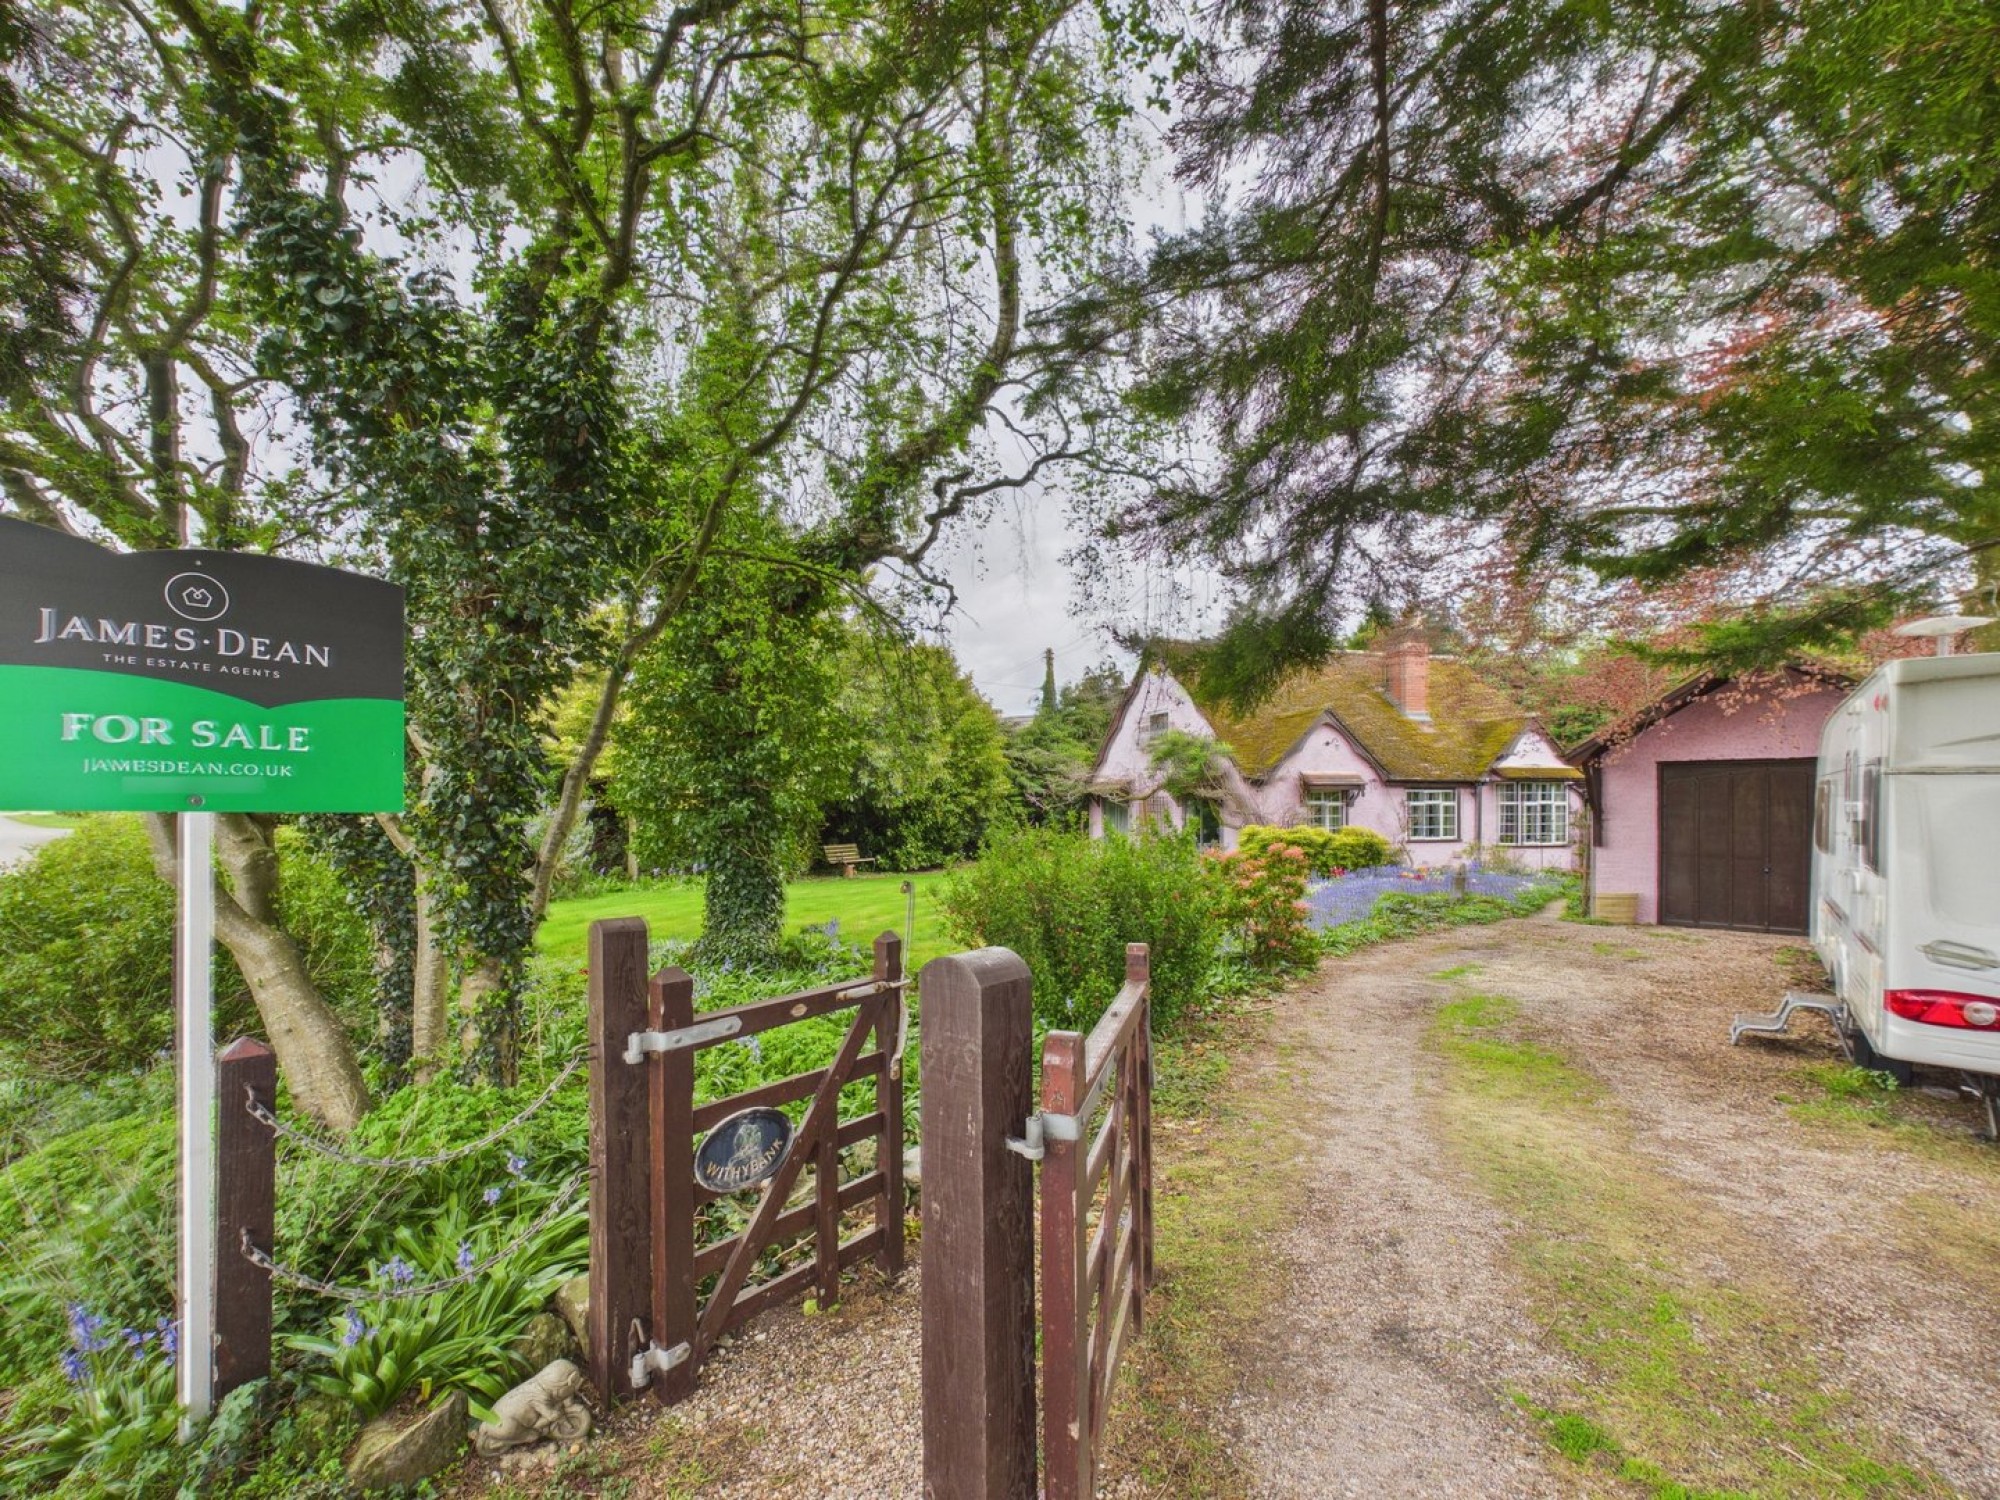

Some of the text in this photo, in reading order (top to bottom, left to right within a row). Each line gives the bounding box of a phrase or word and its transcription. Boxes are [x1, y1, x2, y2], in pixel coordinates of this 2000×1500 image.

[102, 653, 280, 679] THE ESTATE AGENTS
[60, 713, 312, 752] FOR SALE
[82, 758, 293, 777] JAMESDEAN.CO.UK
